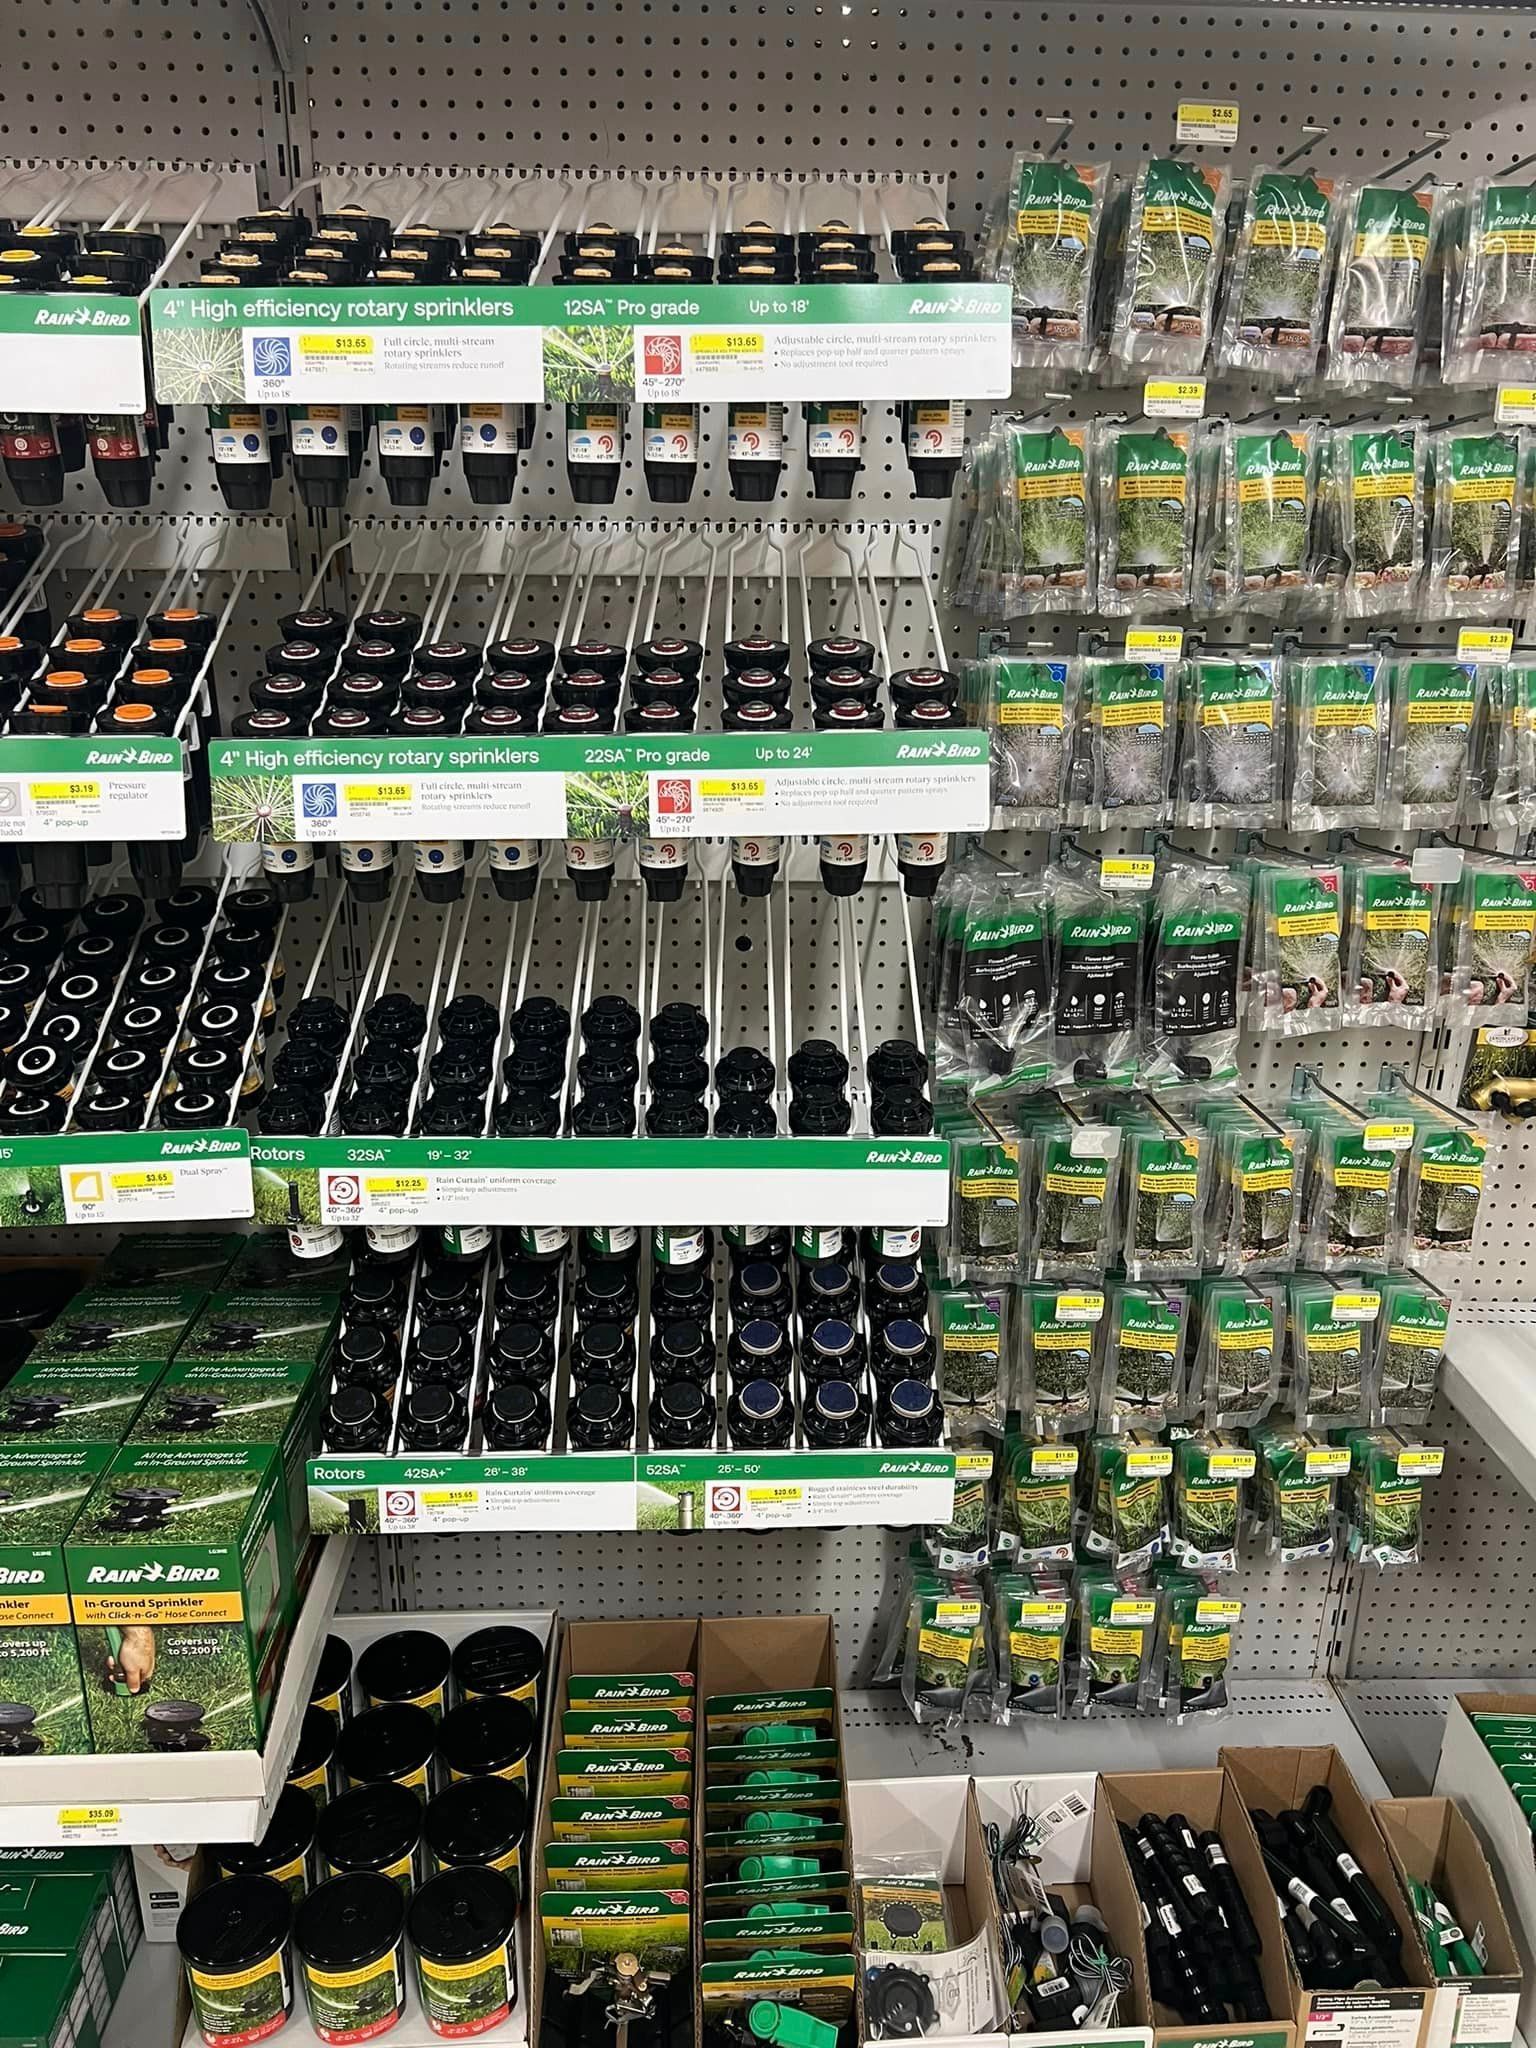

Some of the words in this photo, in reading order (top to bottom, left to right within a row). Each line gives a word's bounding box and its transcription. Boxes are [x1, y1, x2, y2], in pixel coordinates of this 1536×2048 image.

[1212, 108, 1232, 118] $2.65
[1026, 194, 1052, 205] RAIN
[1062, 195, 1086, 208] BIRD
[1153, 190, 1180, 202] RAIN
[1188, 196, 1209, 210] BIRD
[163, 300, 185, 318] 4"
[192, 300, 237, 322] High
[244, 299, 339, 322] efficiency
[348, 302, 408, 323] rotary
[414, 298, 514, 321] sprinklers
[618, 301, 646, 315] Pro
[650, 301, 700, 319] grade
[750, 301, 769, 316] Up
[773, 301, 788, 314] to
[792, 300, 810, 314] 18'
[909, 299, 949, 315] RAIN
[965, 300, 1002, 314] BIRD
[34, 310, 75, 325] RAIN
[91, 310, 130, 326] BIRD
[335, 338, 367, 349] $13.65
[383, 336, 403, 347] Full
[405, 337, 431, 348] circle,
[433, 336, 494, 347] multi-stream
[726, 336, 757, 348] $13.65
[774, 334, 825, 345] Adjustable
[827, 334, 854, 345] circle,
[856, 334, 916, 344] multi-stream
[918, 335, 945, 346] rotary
[947, 334, 996, 346] sprinklers
[383, 349, 408, 360] rotary
[410, 348, 462, 359] sprinklers
[780, 347, 814, 357] Replaces
[846, 346, 861, 356] half
[863, 347, 877, 356] and
[879, 347, 910, 358] quarter
[912, 347, 939, 358] pattern
[780, 359, 791, 368] No
[793, 358, 835, 369] adjustment
[838, 358, 853, 367] tool
[855, 358, 888, 369] required
[262, 378, 285, 389] 360°
[1178, 386, 1198, 394] $2.39
[1024, 461, 1047, 472] RAIN
[1058, 460, 1080, 470] BIRD
[1126, 461, 1150, 472] RAIN
[1159, 460, 1181, 471] BIRD
[1157, 634, 1176, 642] $2.59
[1007, 688, 1031, 699] RAIN
[1039, 689, 1058, 699] BIRD
[1108, 690, 1130, 701] RAIN
[1137, 688, 1158, 699] BIRD
[1416, 687, 1441, 698] RAIN
[1449, 687, 1471, 697] BIRD
[86, 750, 123, 765] RAIN
[138, 750, 173, 764] BIRD
[636, 749, 661, 763] Pro
[666, 749, 711, 765] grade
[755, 748, 773, 763] Up
[776, 748, 790, 760] to
[793, 747, 813, 759] 24'
[896, 744, 933, 760] RAIN
[947, 744, 981, 759] BIRD
[220, 751, 240, 767] 4"
[246, 750, 288, 771] High
[294, 749, 383, 770] efficiency
[389, 751, 443, 768] rotary
[449, 748, 539, 766] sprinklers
[70, 784, 93, 793] $3.19
[109, 781, 147, 790] Pressure
[377, 786, 405, 796] $13.65
[730, 781, 759, 792] $13.65
[109, 791, 148, 800] regulator
[55, 819, 88, 828] pop-up
[310, 819, 332, 828] 360°
[1283, 903, 1306, 913] RAIN
[1315, 901, 1334, 909] BIRD
[1372, 898, 1395, 908] RAIN
[1403, 897, 1426, 908] BIRD
[972, 930, 1000, 942] RAIN
[1008, 922, 1034, 936] BIRD
[1070, 926, 1100, 938] RAIN
[1172, 924, 1204, 938] RAIN
[160, 1142, 193, 1155] RAIN
[208, 1141, 241, 1153] BIRD
[250, 1146, 305, 1161] Rotors
[866, 1151, 897, 1164] RAIN
[911, 1151, 943, 1163] BIRD
[1339, 1156, 1363, 1166] RAIN
[1371, 1158, 1392, 1168] BIRD
[180, 1168, 199, 1176] Dual
[1146, 1162, 1167, 1172] RAIN
[1172, 1162, 1192, 1171] BIRD
[146, 1174, 168, 1182] $3.65
[396, 1179, 421, 1188] $12.25
[436, 1177, 454, 1185] Rain
[489, 1177, 520, 1185] uniform
[521, 1178, 557, 1186] coverage
[389, 1206, 419, 1216] pop-up
[171, 1452, 230, 1460] Advantages
[235, 1451, 249, 1459] of
[151, 1459, 199, 1467] In-Ground
[199, 1458, 249, 1467] Sprinkler
[879, 1463, 908, 1473] RAIN
[920, 1463, 949, 1473] BIRD
[314, 1467, 366, 1480] Rotors
[765, 1512, 792, 1520] pop-up
[87, 1566, 142, 1584] RAIN
[165, 1565, 220, 1582] BIRD
[84, 1599, 146, 1608] In-Ground
[148, 1598, 204, 1609] Sprinkler
[16, 1611, 54, 1620] Connect
[165, 1610, 188, 1618] Hose
[168, 1638, 202, 1646] Covers
[203, 1638, 218, 1648] up
[168, 1647, 180, 1655] to
[182, 1646, 208, 1656] 5,200
[594, 1688, 626, 1698] RAIN
[639, 1687, 670, 1697] BIRD
[584, 1764, 618, 1774] RAIN
[632, 1762, 665, 1772] BIRD
[88, 1809, 114, 1818] $35.09
[33, 1850, 64, 1860] BIRD
[575, 1857, 610, 1866] RAIN
[626, 1856, 661, 1865] BIRD
[571, 1906, 607, 1916] RAIN
[623, 1905, 660, 1915] BIRD
[734, 1971, 772, 1979] RAIN
[787, 1968, 824, 1976] BIRD
